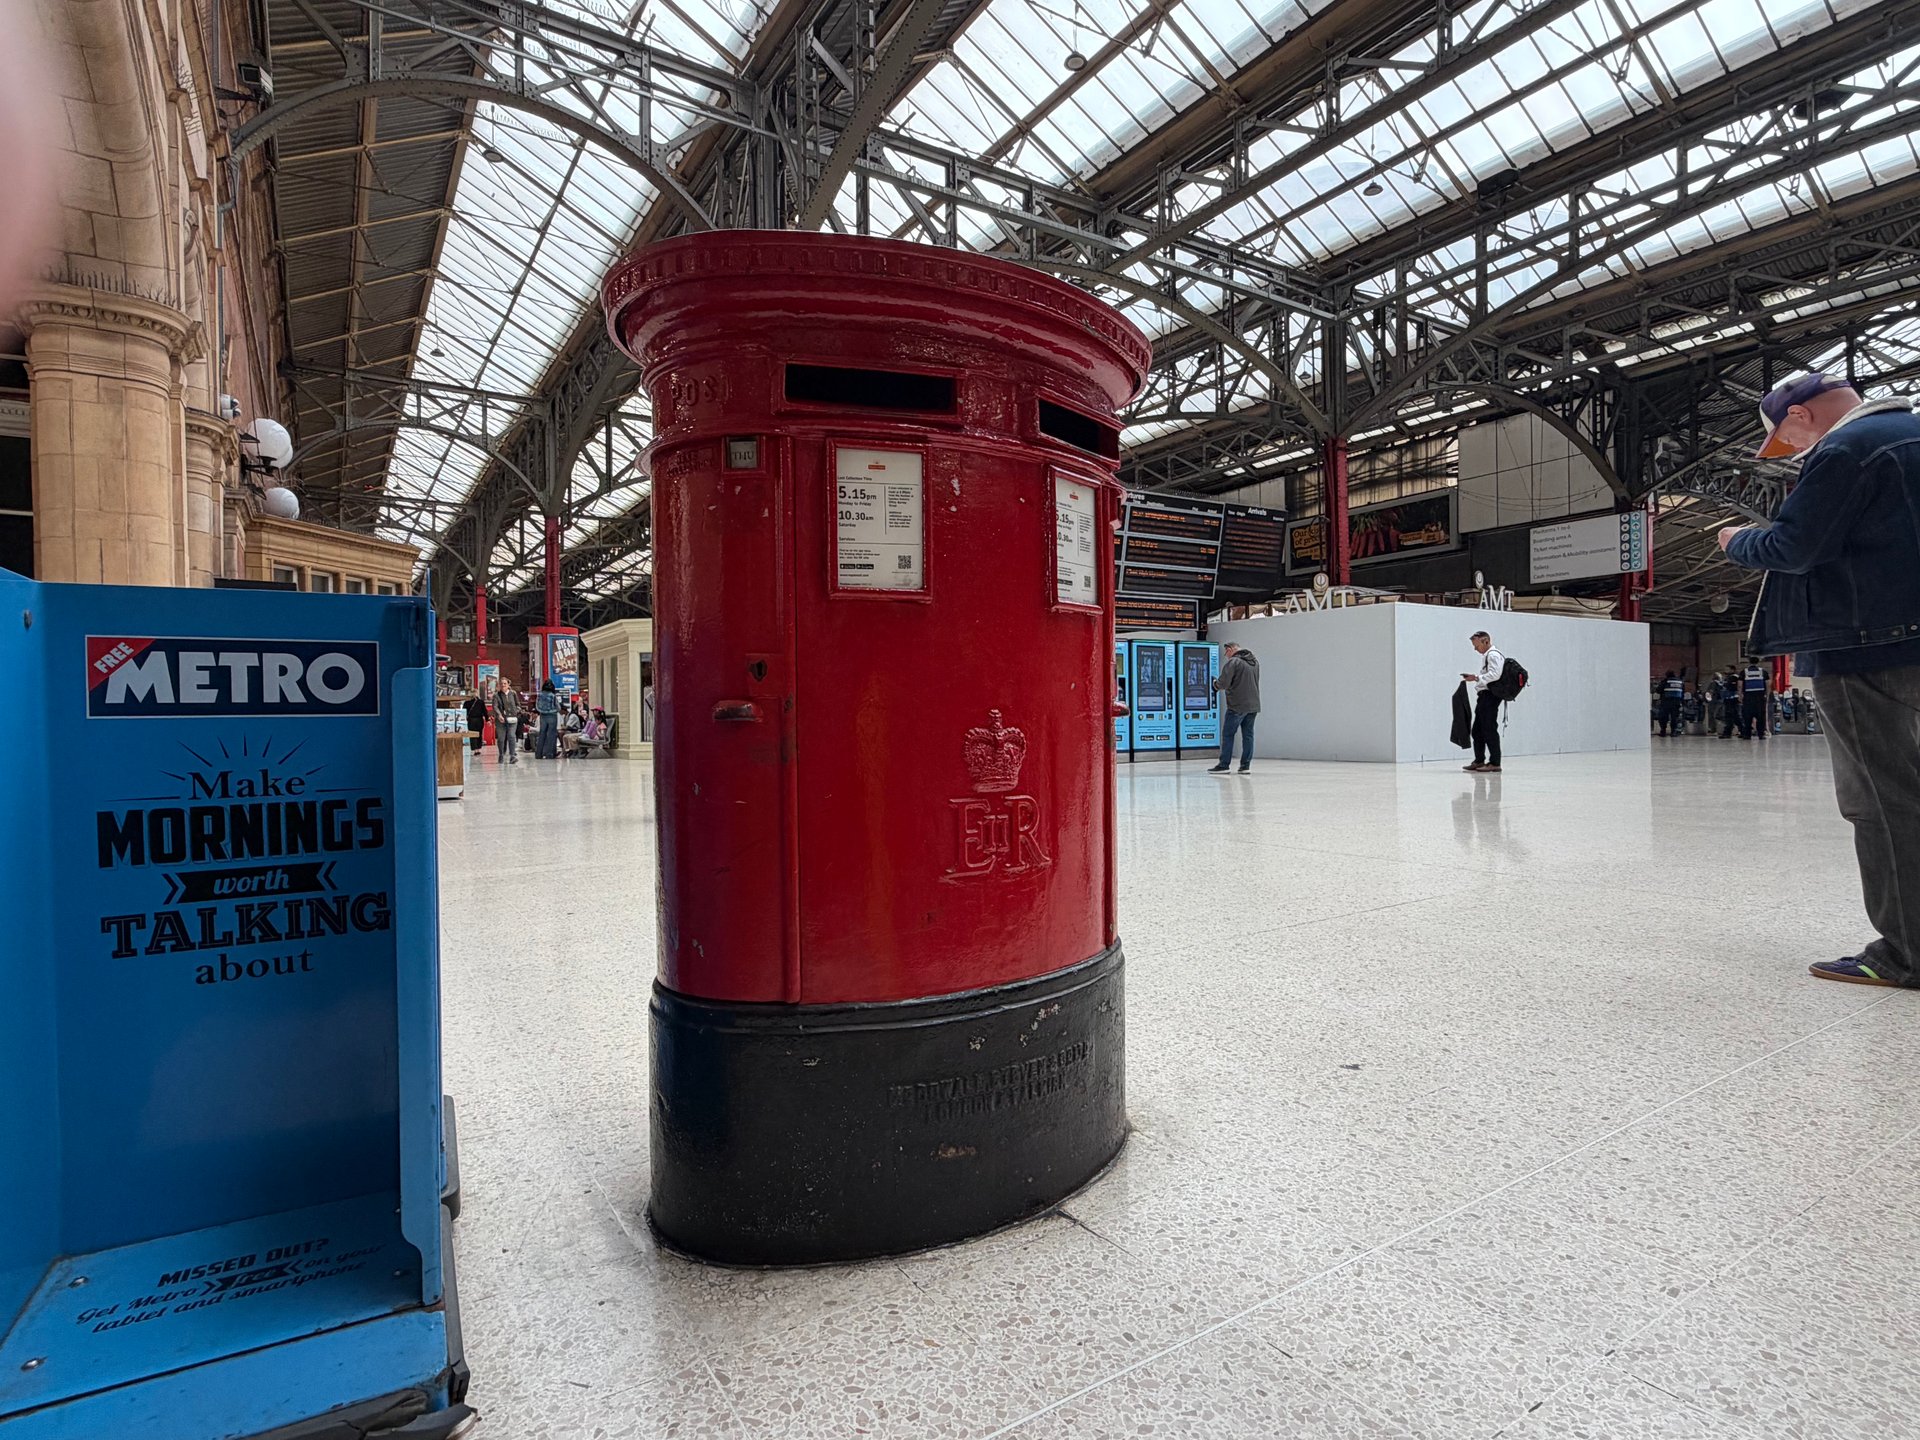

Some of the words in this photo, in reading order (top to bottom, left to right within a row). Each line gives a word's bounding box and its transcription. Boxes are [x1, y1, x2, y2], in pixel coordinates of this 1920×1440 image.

[732, 451, 754, 461] THU
[838, 485, 877, 501] 5.15pm
[838, 510, 874, 521] 10.30am
[1247, 507, 1267, 516] Arrivals
[1286, 589, 1354, 614] AMT
[1479, 585, 1515, 611] AMT
[94, 641, 134, 674] FREE
[104, 651, 366, 704] METRO
[187, 769, 306, 800] Make
[96, 797, 386, 870] MORNINGS
[213, 868, 290, 895] worth
[100, 892, 392, 959] TALKING
[194, 949, 314, 985] about
[157, 1253, 257, 1287] MISSED
[266, 1237, 330, 1263] OUT?
[76, 1303, 121, 1325] Get
[127, 1287, 198, 1311] Metro
[230, 1268, 277, 1289] free
[303, 1256, 331, 1270] on
[336, 1243, 387, 1263] your
[92, 1306, 168, 1334] tablet
[173, 1292, 225, 1314] and
[229, 1261, 367, 1300] smartphone
